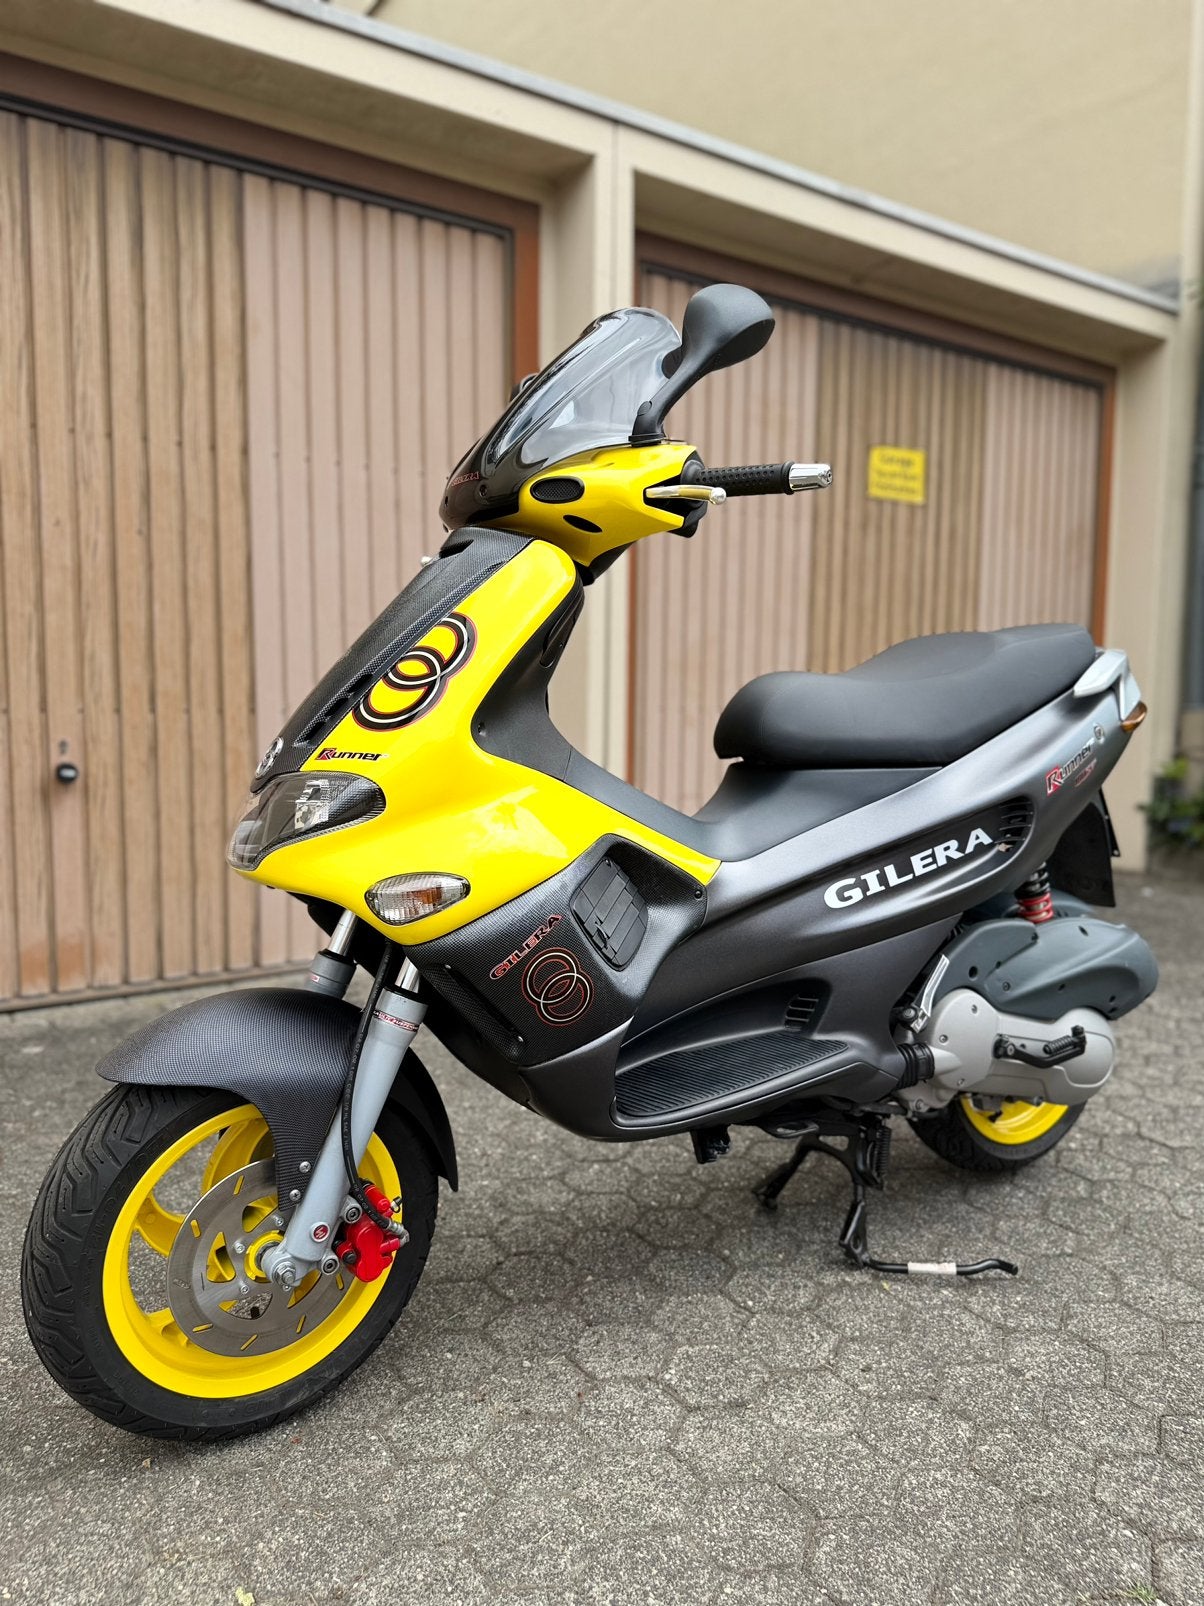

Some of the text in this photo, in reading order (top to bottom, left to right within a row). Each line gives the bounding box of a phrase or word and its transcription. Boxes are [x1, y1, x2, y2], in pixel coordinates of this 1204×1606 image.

[314, 747, 382, 761] Runner
[1045, 737, 1095, 797] Runner
[823, 827, 993, 909] GILERA
[489, 914, 563, 980] GILERA
